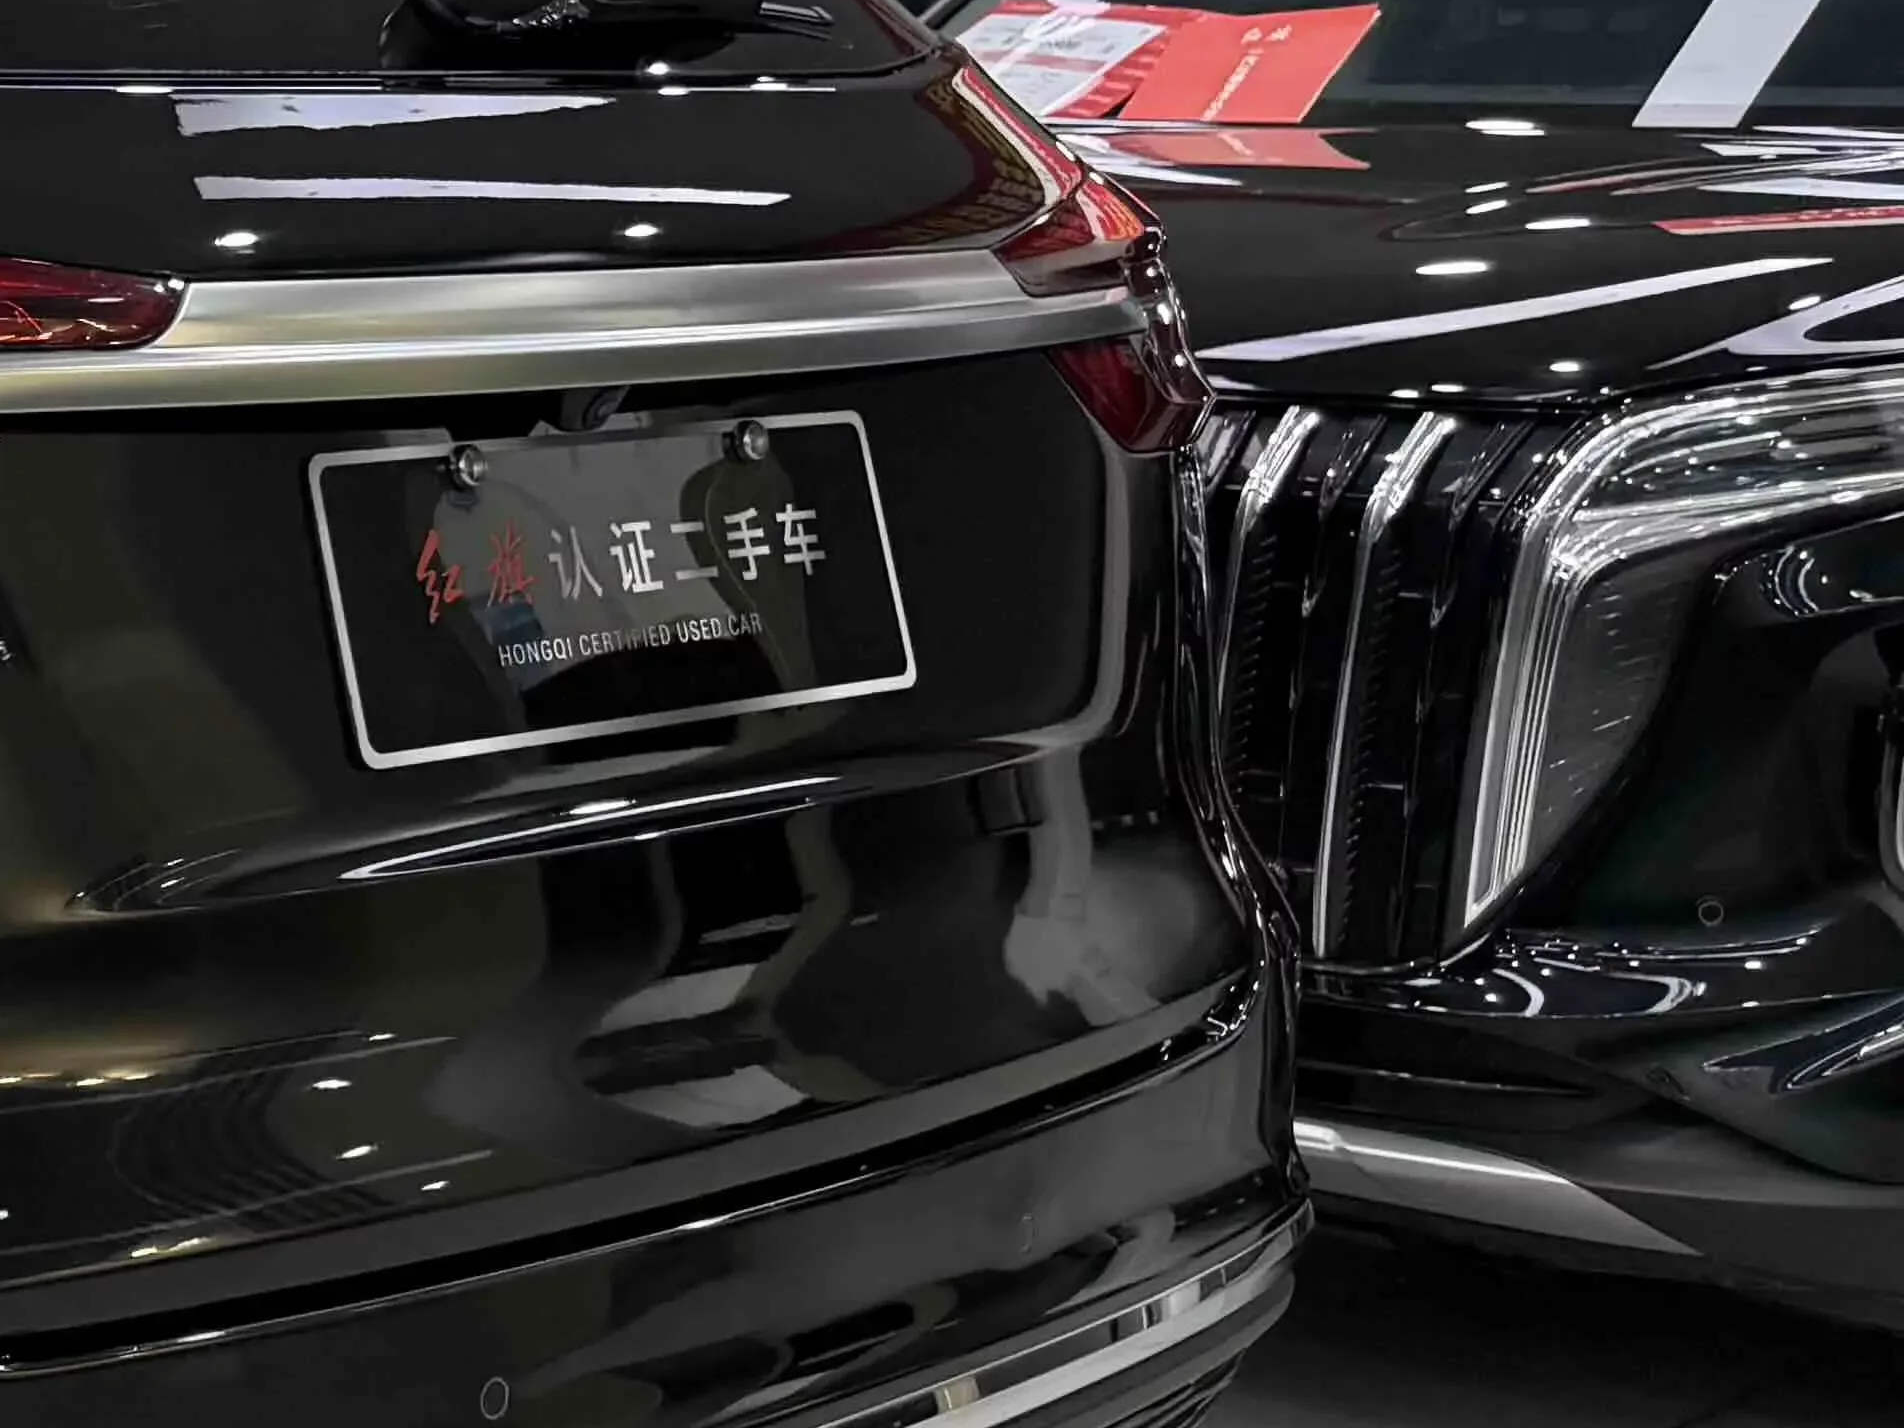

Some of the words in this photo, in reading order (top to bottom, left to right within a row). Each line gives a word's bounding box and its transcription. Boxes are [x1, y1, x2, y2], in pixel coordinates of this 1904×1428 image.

[498, 638, 574, 667] HONGQI
[579, 623, 671, 656] CERTIFIED
[675, 617, 722, 643] USED
[726, 612, 763, 636] CAR
